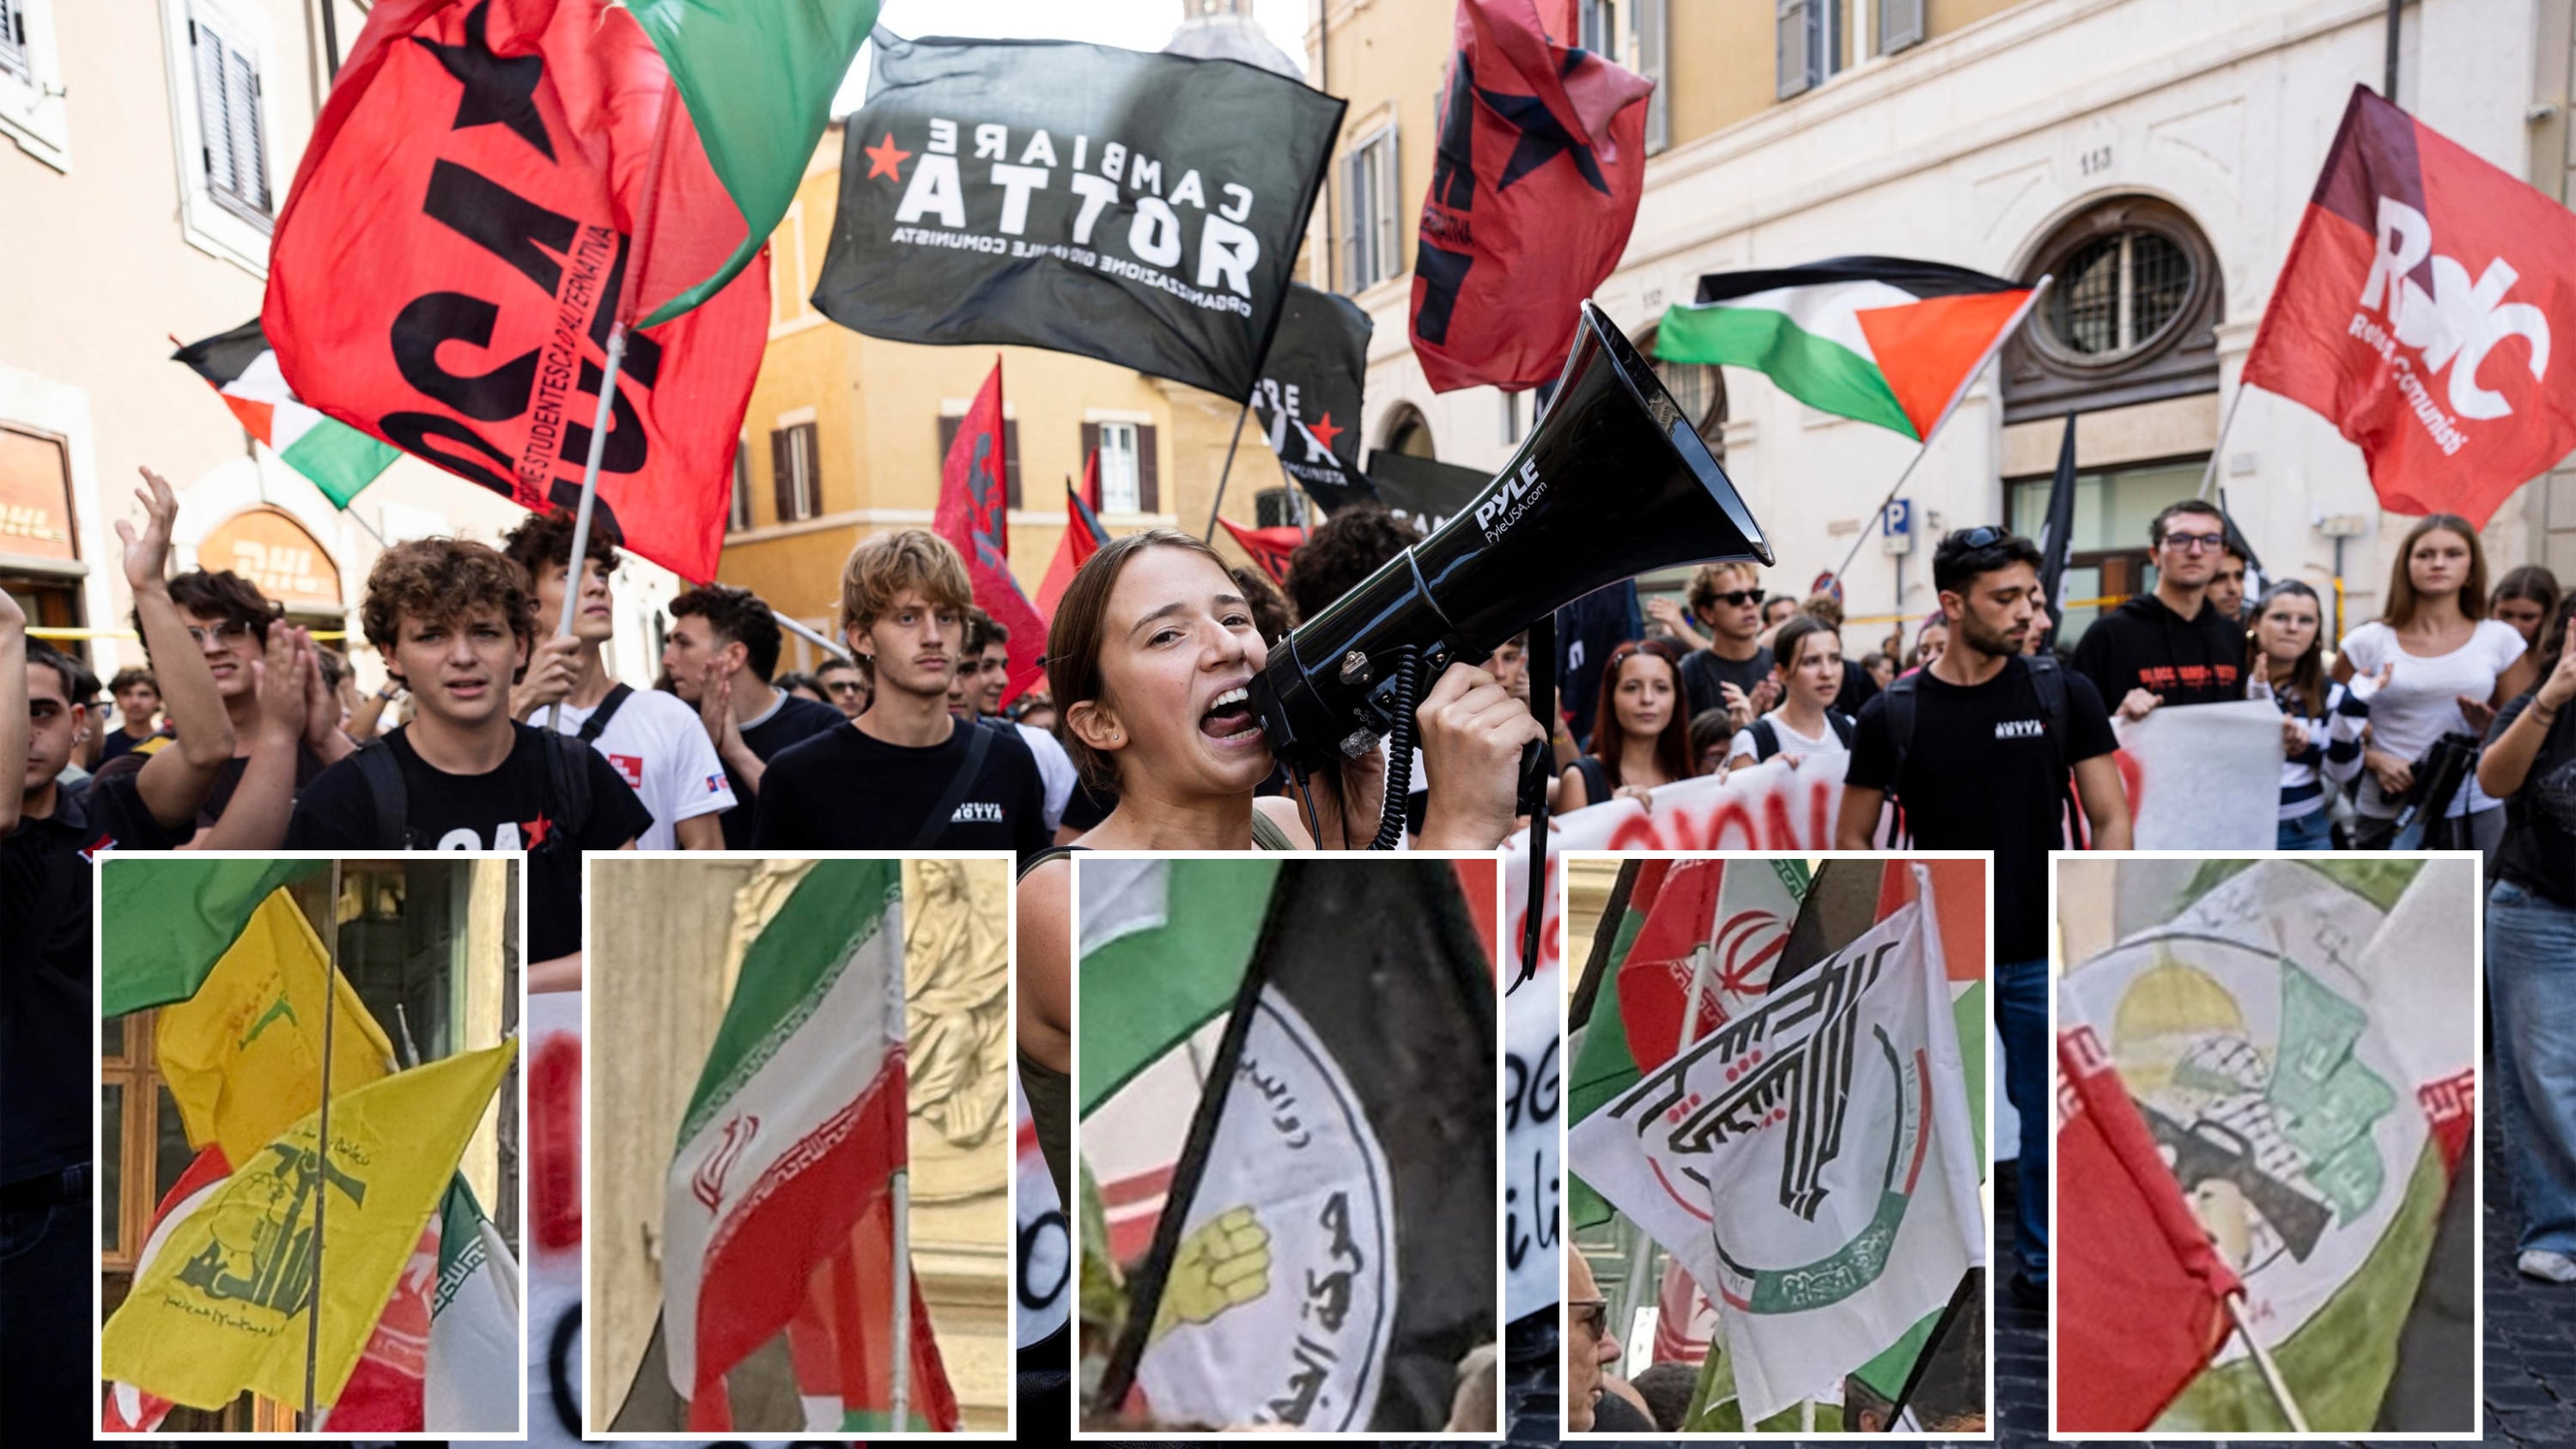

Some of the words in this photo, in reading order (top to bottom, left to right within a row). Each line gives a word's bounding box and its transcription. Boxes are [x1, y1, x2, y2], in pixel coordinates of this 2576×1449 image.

[2080, 146, 2112, 177] 113
[523, 344, 575, 467] STUDENTESCA
[556, 224, 614, 349] D'ALTERNATIVA
[1475, 456, 1540, 531] PYLE
[1484, 482, 1547, 544] PyleUSA.com
[1887, 502, 1905, 533] P
[1306, 1190, 1367, 1334] حركة
